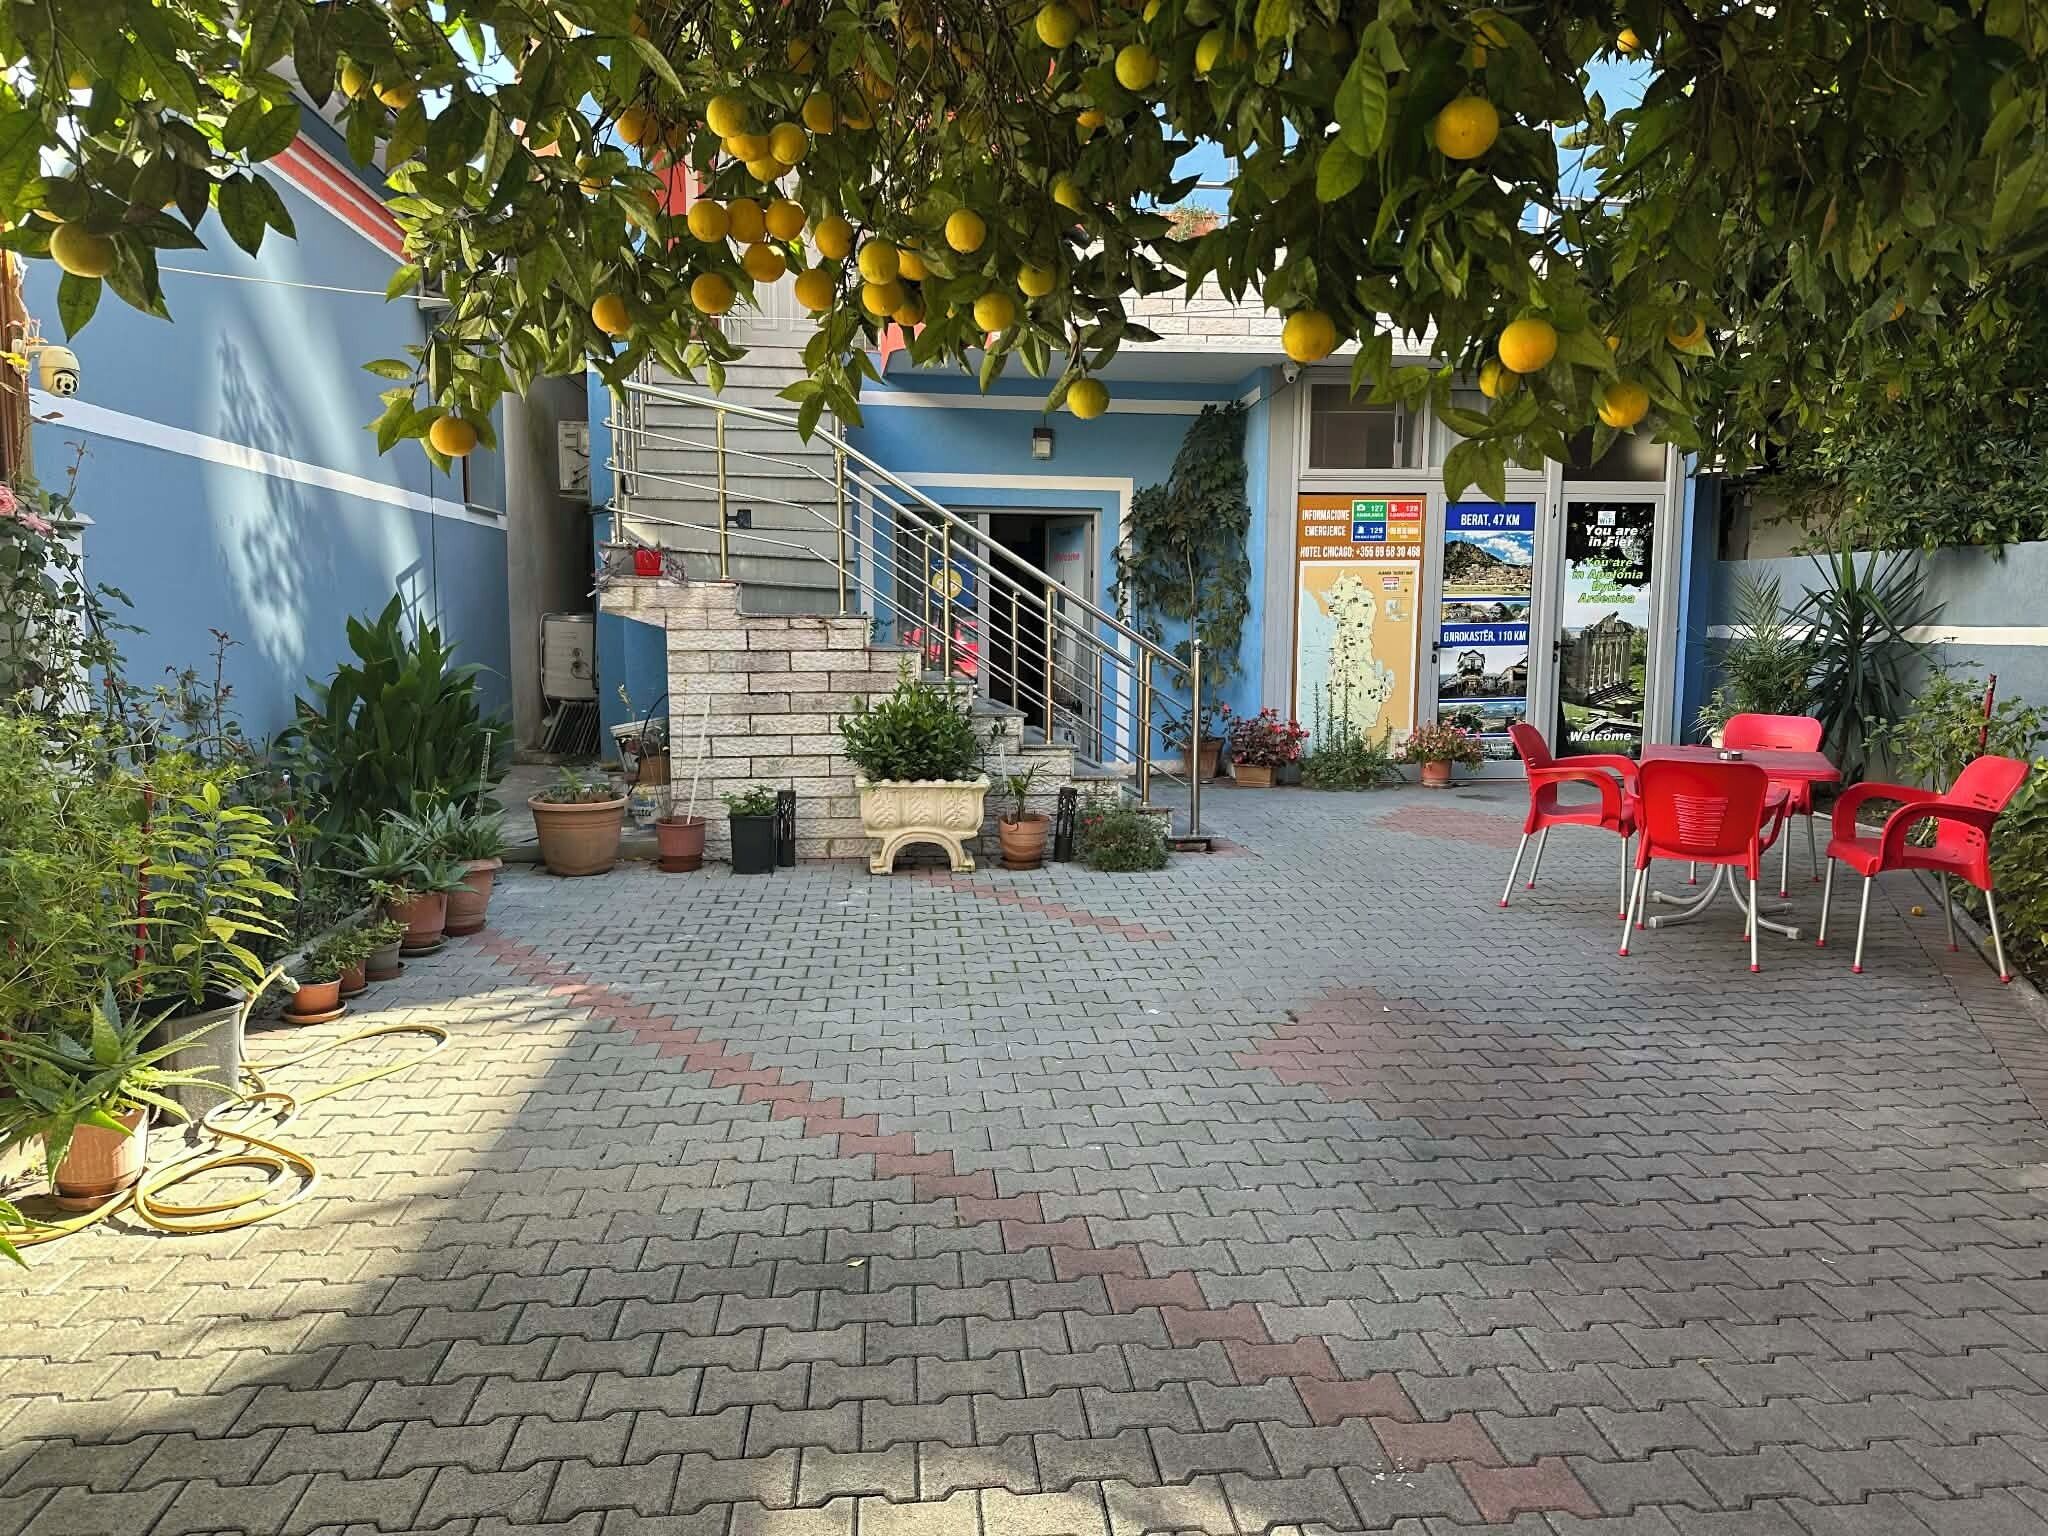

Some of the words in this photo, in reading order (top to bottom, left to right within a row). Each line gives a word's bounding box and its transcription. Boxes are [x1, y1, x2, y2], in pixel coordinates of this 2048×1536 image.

[1302, 509, 1350, 521] INFORMACIONE
[1460, 514, 1491, 526] BERAT,
[1492, 514, 1505, 526] 47
[1506, 514, 1520, 526] KM
[1585, 525, 1612, 536] You
[1615, 527, 1638, 536] are
[1588, 536, 1601, 547] in
[1605, 536, 1633, 547] Fier
[1300, 546, 1321, 558] HOTEL
[1323, 546, 1354, 558] CHICAGO:
[1585, 557, 1609, 567] You
[1613, 559, 1633, 567] are
[1572, 570, 1584, 579] in
[1499, 630, 1512, 641] 110
[1514, 630, 1527, 641] KM
[1570, 730, 1632, 742] Welcome
